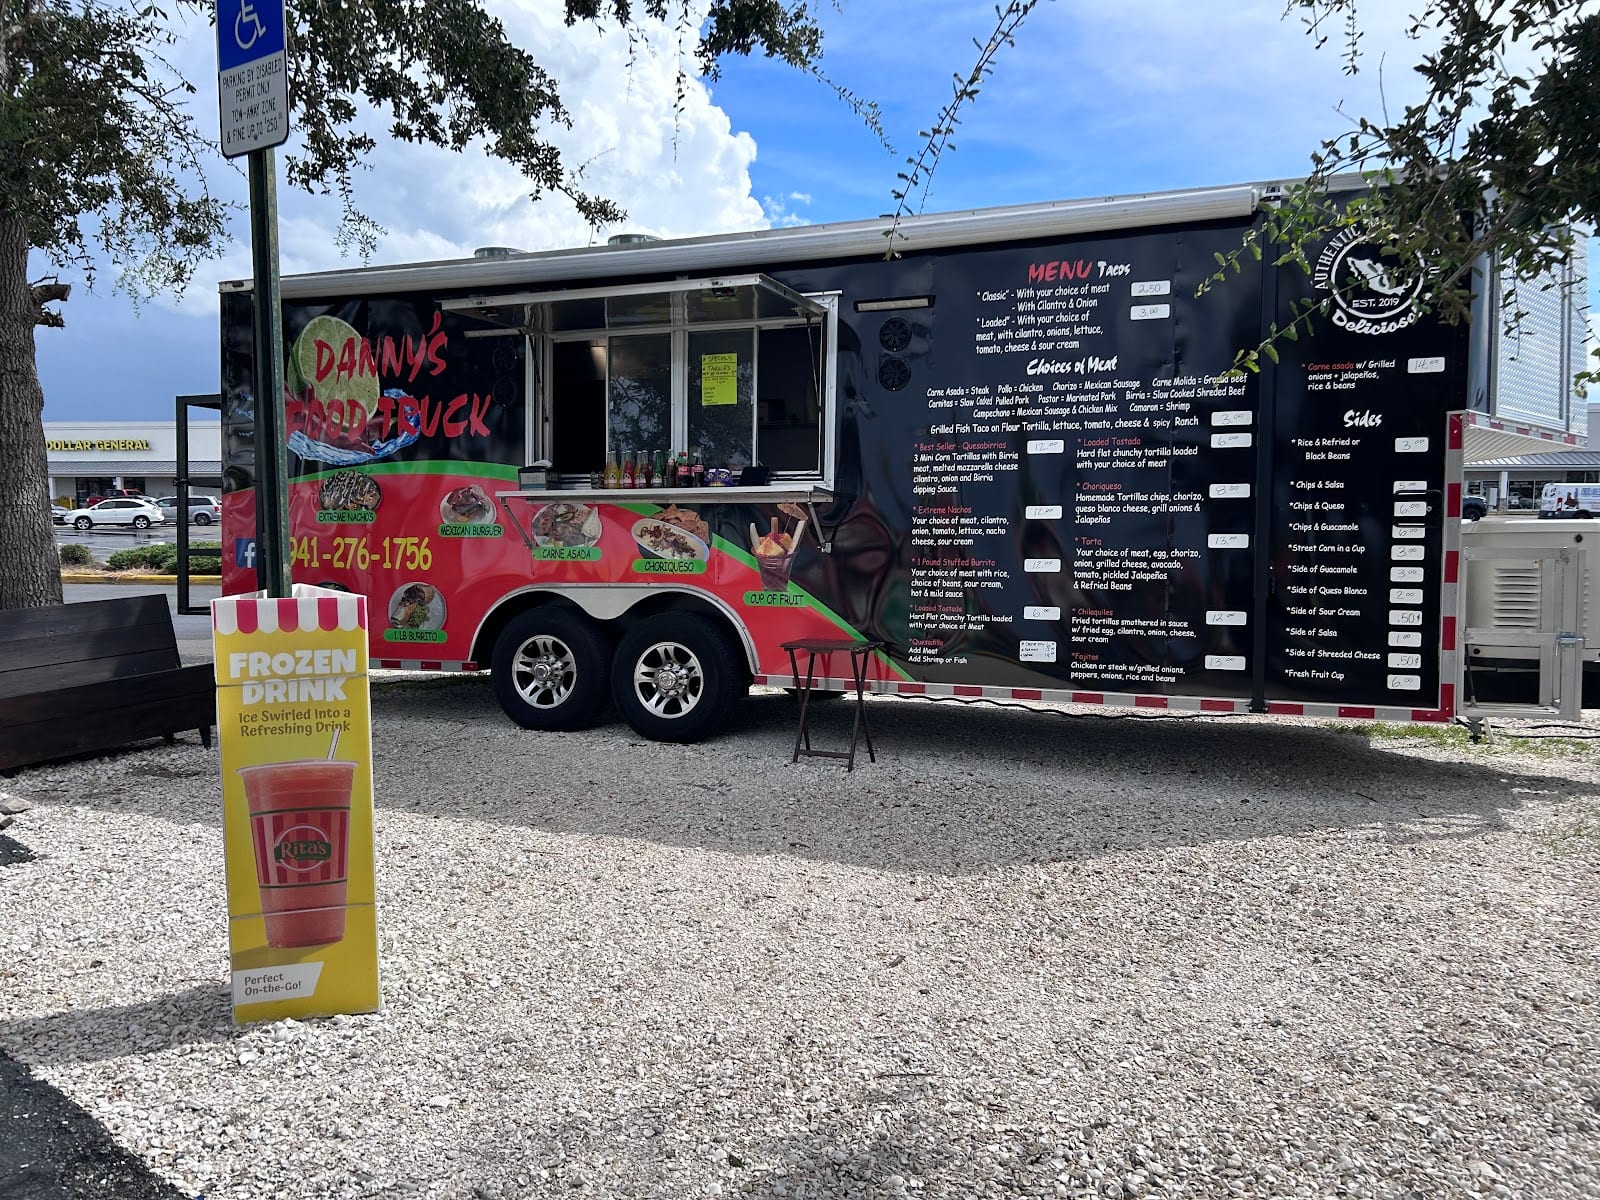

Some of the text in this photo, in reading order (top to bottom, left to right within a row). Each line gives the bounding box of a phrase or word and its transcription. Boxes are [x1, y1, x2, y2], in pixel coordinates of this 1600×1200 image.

[223, 59, 282, 89] PARKING BY DISABLED
[236, 80, 270, 102] PERMIT ONLY
[232, 97, 276, 123] TOW-AWAY ZONE
[233, 127, 245, 141] FINE
[247, 125, 254, 138] UP
[256, 122, 262, 135] TO
[1315, 223, 1361, 290] AUTHENTIC
[1028, 259, 1131, 284] MENU Tacos
[1352, 298, 1400, 308] EST. 2019
[976, 325, 1104, 342] meat, with cilantro, onions, lettuce,
[314, 311, 449, 383] DANNY'S
[976, 340, 1080, 355] tomato, cheese & sour cream
[1026, 355, 1118, 376] Choices of Meat
[1308, 382, 1323, 391] rice
[286, 393, 491, 442] FOOD TRUCK
[1343, 410, 1383, 427] Sides
[931, 424, 953, 434] Grilled
[956, 423, 970, 433] Fish
[972, 423, 989, 433] Taco
[1002, 422, 1020, 432] Flour
[1022, 421, 1051, 432] Tortilla,
[1053, 420, 1082, 430] lettuce,
[1084, 419, 1112, 429] tomato,
[1115, 418, 1142, 428] cheese
[1144, 418, 1149, 427] &
[1153, 419, 1170, 427] spicy
[1175, 416, 1199, 426] Ranch
[46, 440, 151, 451] DOLLAR GENERAL
[914, 454, 918, 462] 3
[920, 453, 933, 461] Mini
[935, 453, 950, 461] Corn
[952, 452, 980, 460] Tortillas
[999, 451, 1018, 459] Birria
[1077, 446, 1198, 458] Hard flat chunchy tortilla loaded
[1306, 452, 1326, 460] Black
[913, 465, 931, 473] meat,
[933, 464, 955, 472] melted
[957, 463, 993, 471] mozzarella
[1077, 458, 1167, 470] with your choice of meat
[913, 475, 940, 483] cilantro,
[973, 473, 993, 481] Birria
[913, 485, 958, 495] dipping Sauce.
[1076, 491, 1204, 502] Homemade Tortillas chips, chorizo,
[319, 512, 346, 522] EXTREME
[912, 516, 1009, 525] Your choice of meat, cilantro,
[1075, 515, 1111, 524] Jalapeños
[440, 526, 471, 535] MEXICAN
[912, 528, 931, 536] onion,
[958, 527, 984, 535] lettuce,
[986, 527, 1006, 535] nacho
[912, 538, 936, 546] cheese,
[542, 550, 591, 560] CARNE ASADA
[644, 562, 694, 574] CHORIQUESO
[1074, 559, 1183, 569] onion, grilled cheese, avocado,
[1074, 570, 1167, 581] tomato, pickled Jalapeños
[1081, 581, 1108, 589] Refried
[1111, 581, 1132, 590] Beans
[750, 594, 804, 606] CUP OF FRUIT
[1072, 617, 1090, 625] Fried
[1092, 617, 1119, 626] tortillas
[1121, 619, 1158, 627] smothered
[1168, 620, 1188, 628] sauce
[394, 631, 437, 641] 1 LB BURRITO
[1308, 628, 1315, 636] of
[1319, 629, 1337, 637] Salsa
[1072, 635, 1086, 643] sour
[229, 648, 356, 678] FROZEN
[1311, 670, 1329, 679] Fruit
[1331, 672, 1344, 681] Cup
[242, 677, 347, 705] DRINK
[239, 709, 350, 723] Ice Swirled Into a
[241, 721, 350, 736] Refreshing Drink
[282, 842, 326, 857] Rita's
[245, 973, 284, 986] Perfect
[245, 981, 301, 996] On-the-Go!
